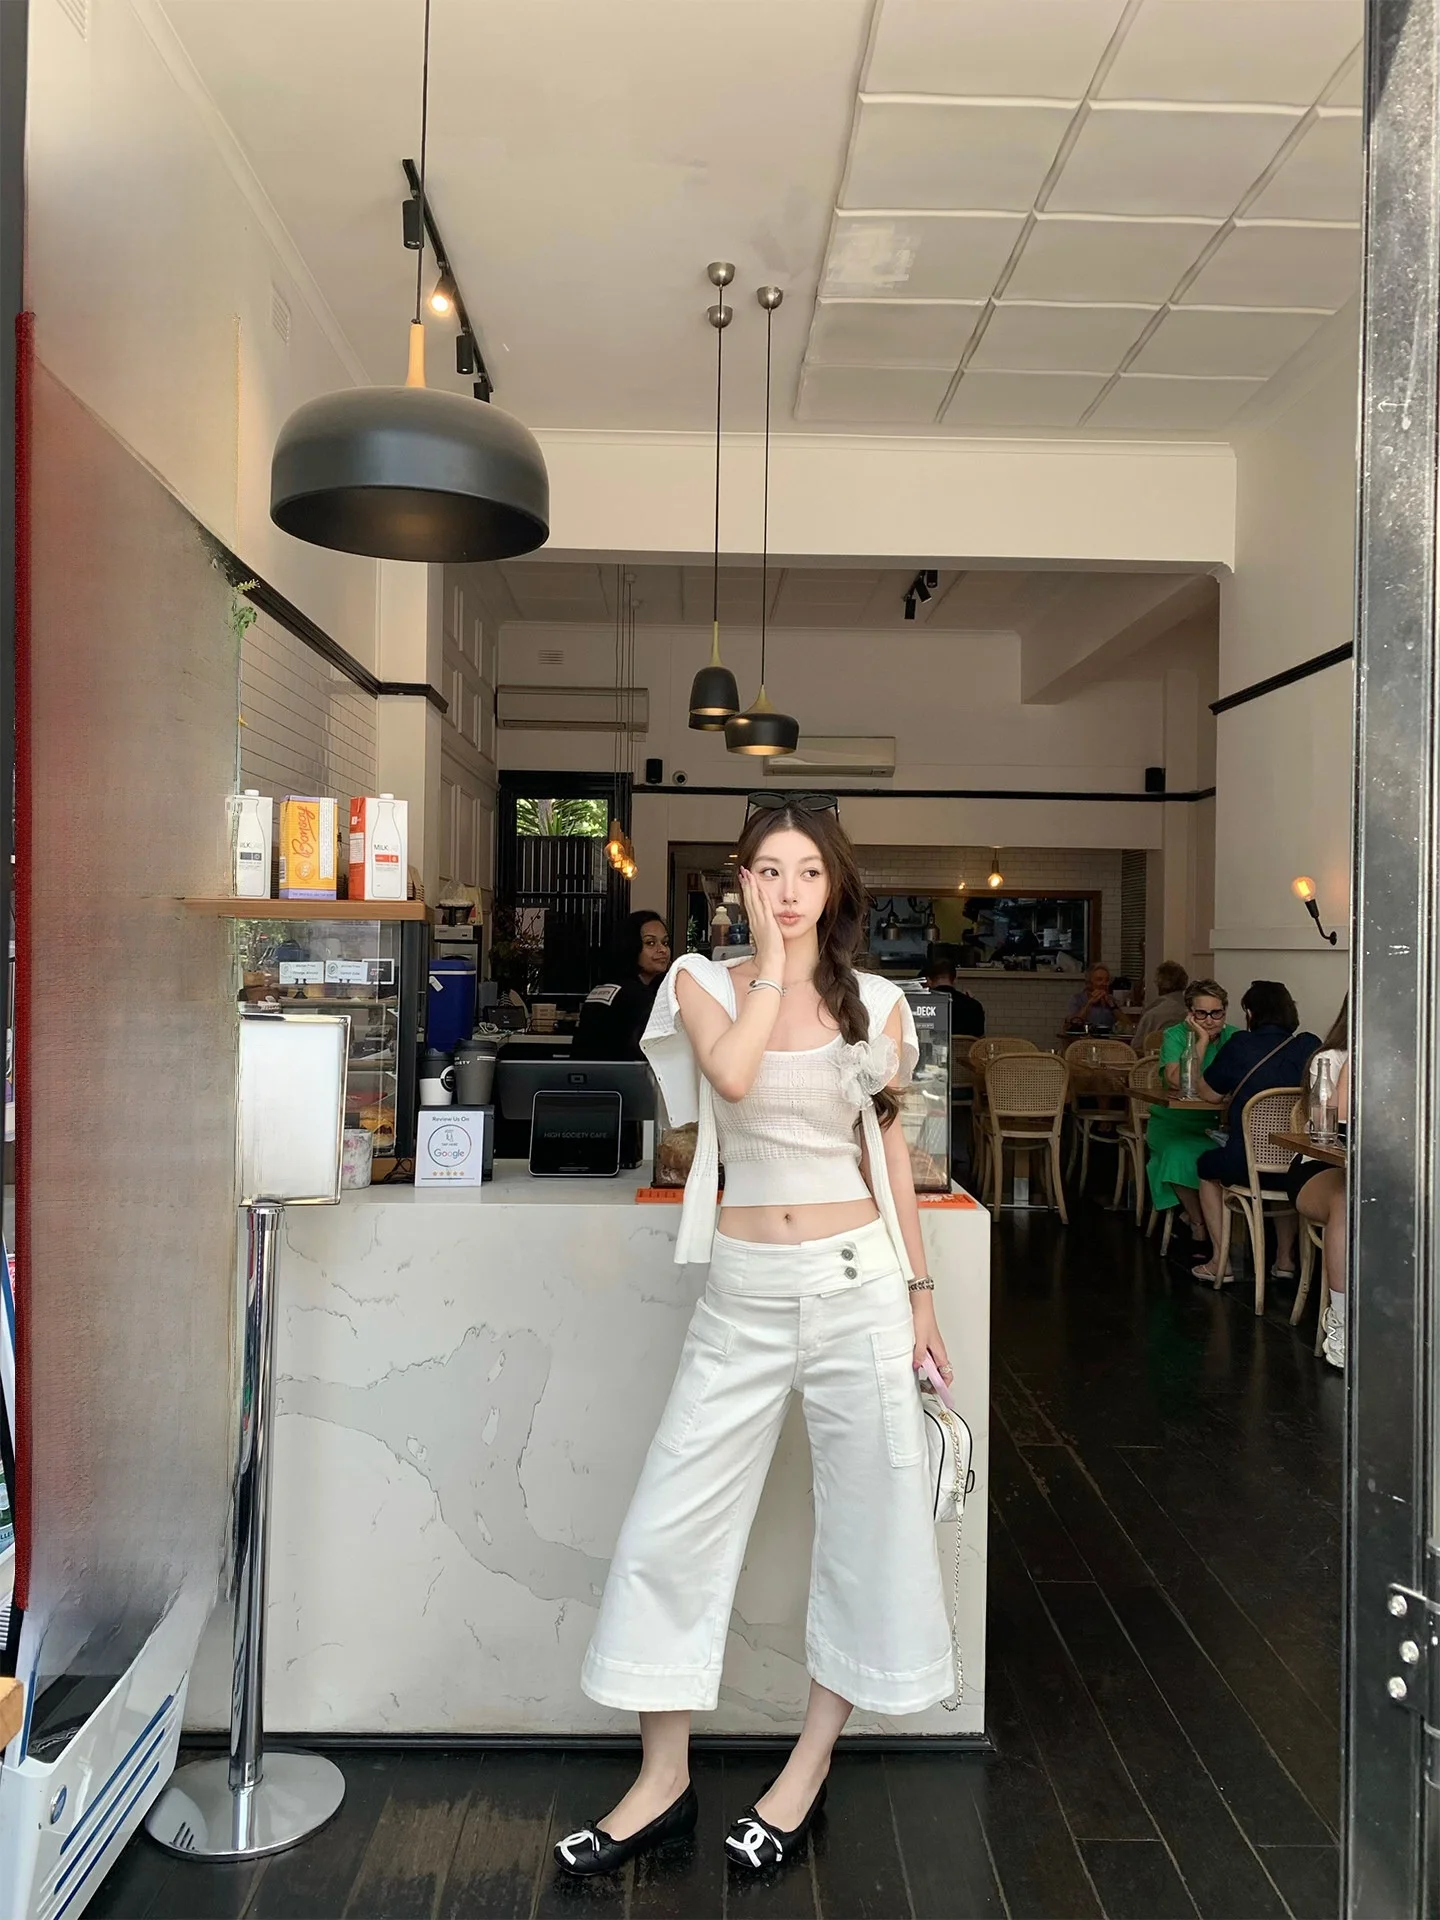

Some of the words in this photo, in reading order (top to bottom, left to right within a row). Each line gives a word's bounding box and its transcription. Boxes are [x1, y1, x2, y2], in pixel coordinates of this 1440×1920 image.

[916, 1006, 937, 1016] DECK
[543, 1131, 561, 1139] HIGH
[561, 1131, 589, 1139] SOCIETY
[433, 1149, 464, 1159] Google
